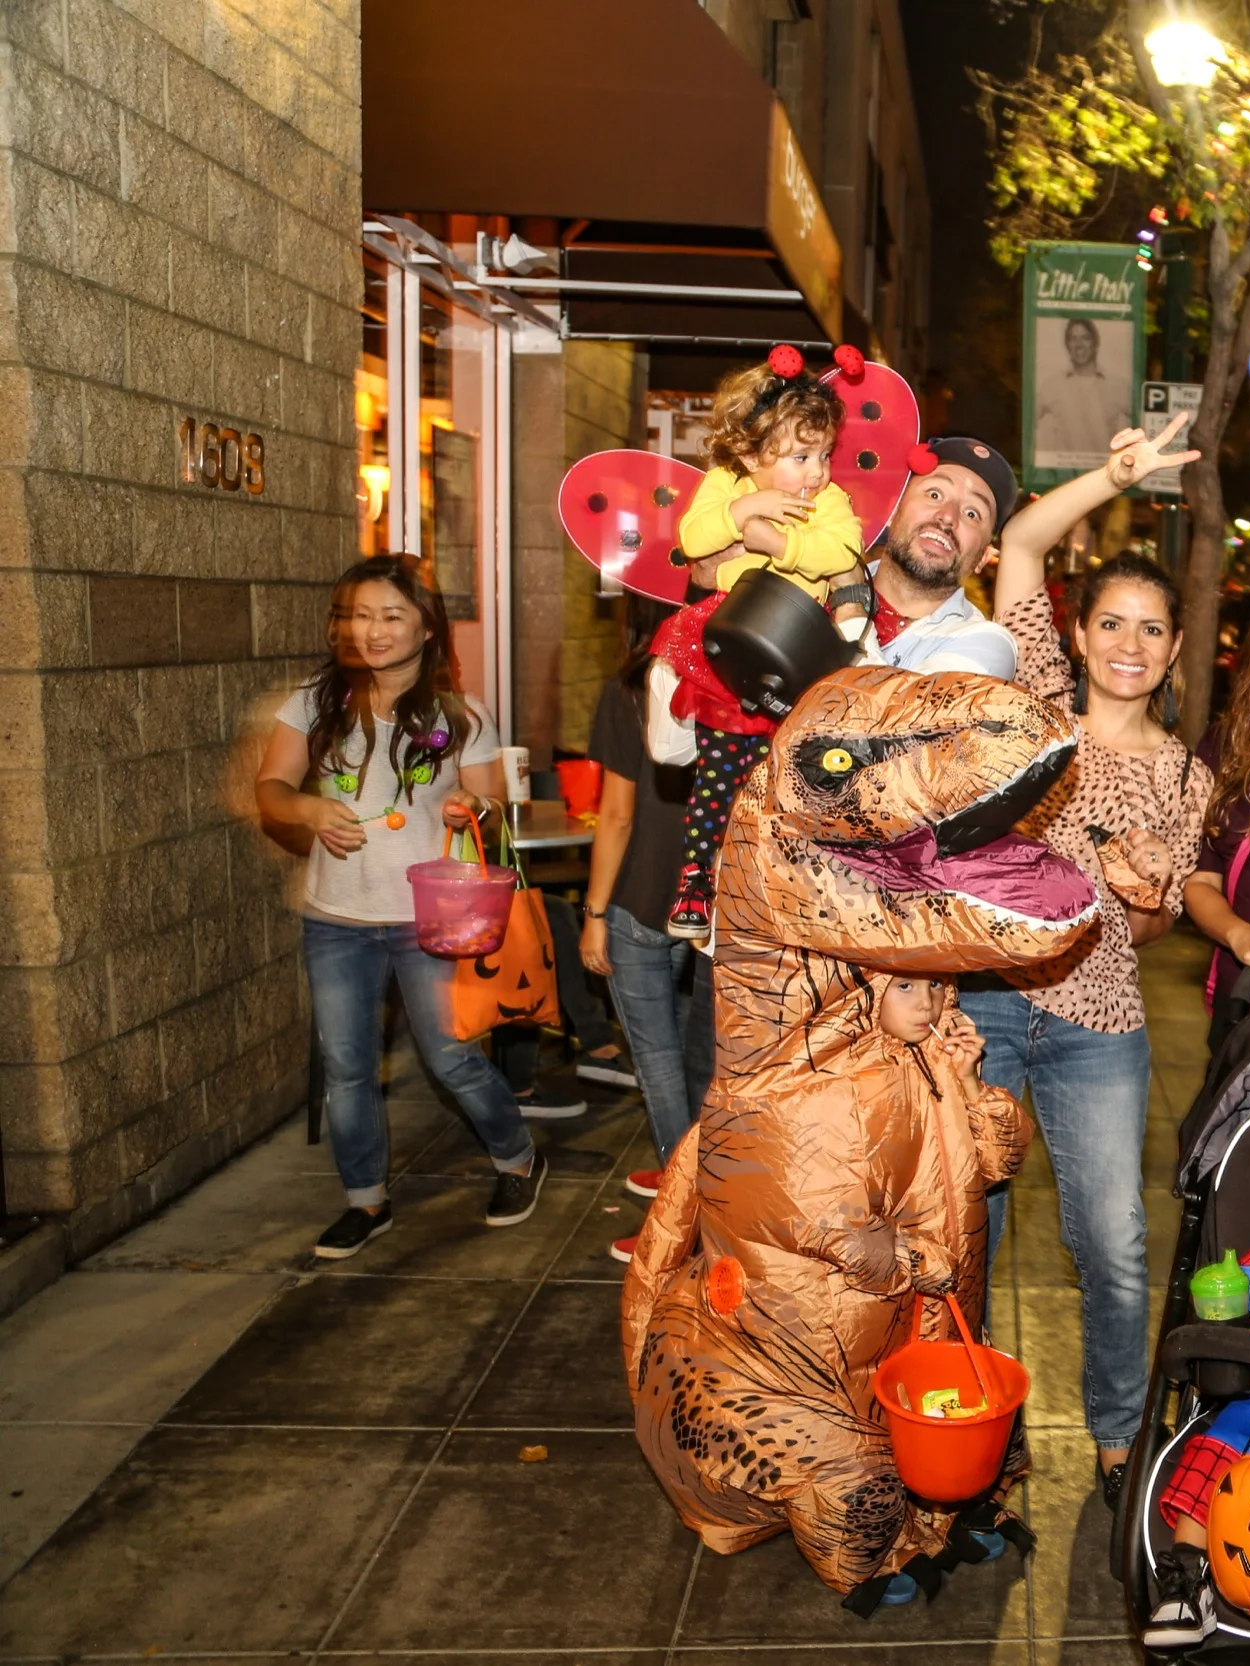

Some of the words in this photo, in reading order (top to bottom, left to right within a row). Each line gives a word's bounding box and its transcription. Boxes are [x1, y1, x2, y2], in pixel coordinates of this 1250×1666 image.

[1036, 260, 1091, 300] Little
[1091, 259, 1136, 316] Italy
[1148, 388, 1166, 410] P
[180, 417, 265, 495] 1608
